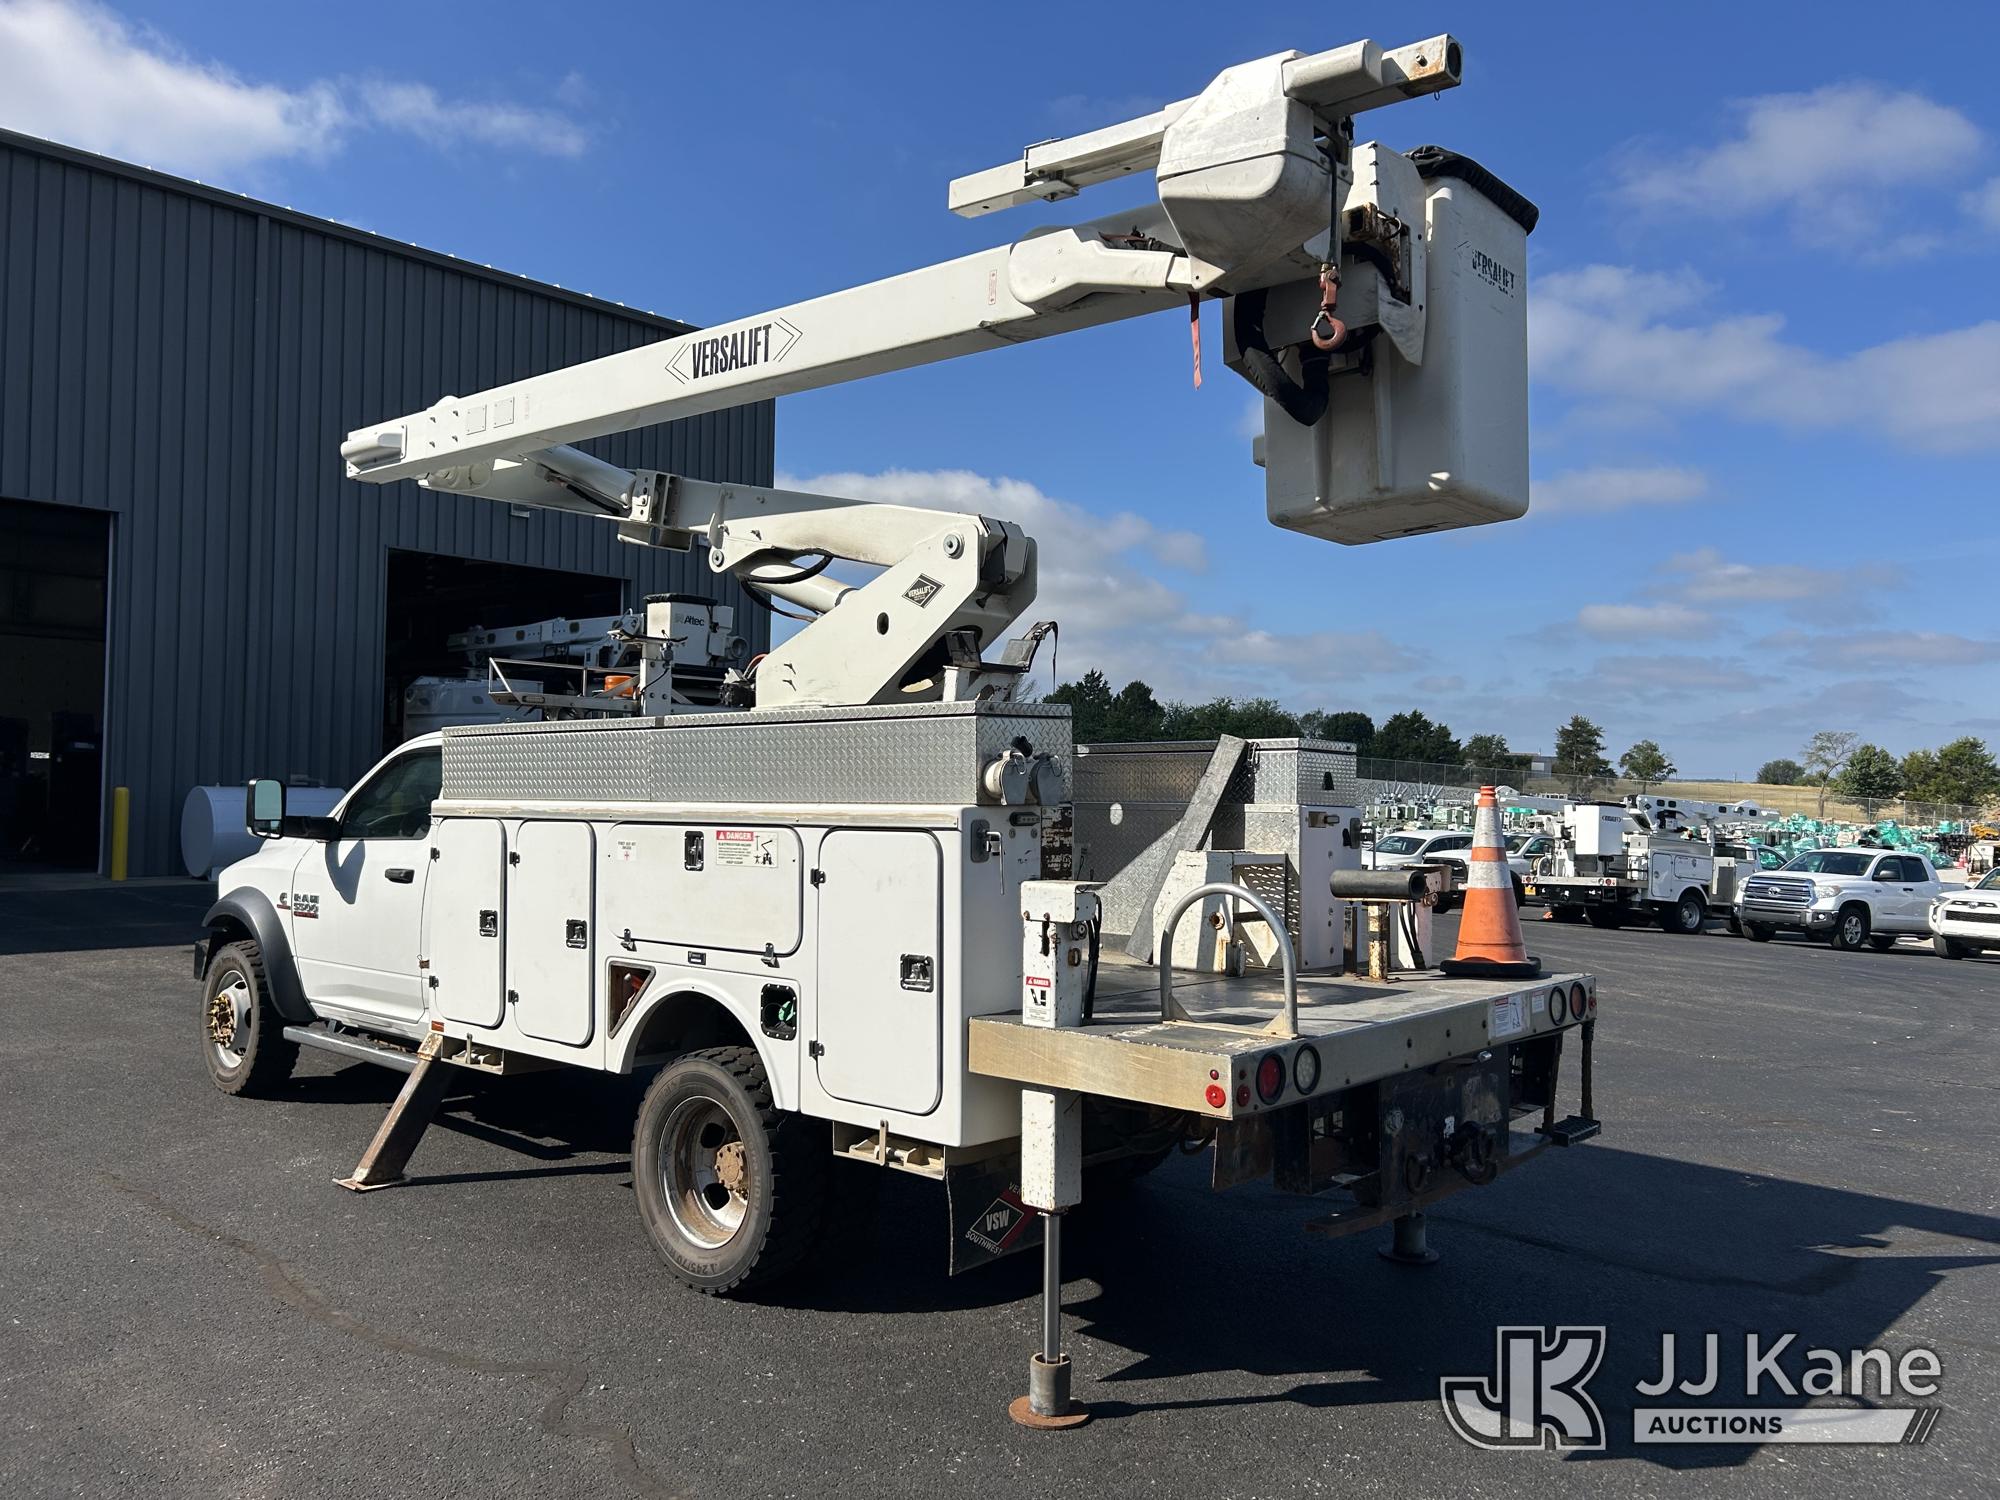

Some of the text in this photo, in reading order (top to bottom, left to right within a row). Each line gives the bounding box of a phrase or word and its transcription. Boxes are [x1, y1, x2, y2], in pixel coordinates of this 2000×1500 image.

[692, 323, 772, 379] VERSALIFT
[684, 615, 705, 626] Altec
[726, 831, 752, 840] DANGER
[293, 893, 320, 904] RAM
[986, 1209, 1010, 1231] VSW
[965, 1230, 1003, 1256] SOUTHWEST
